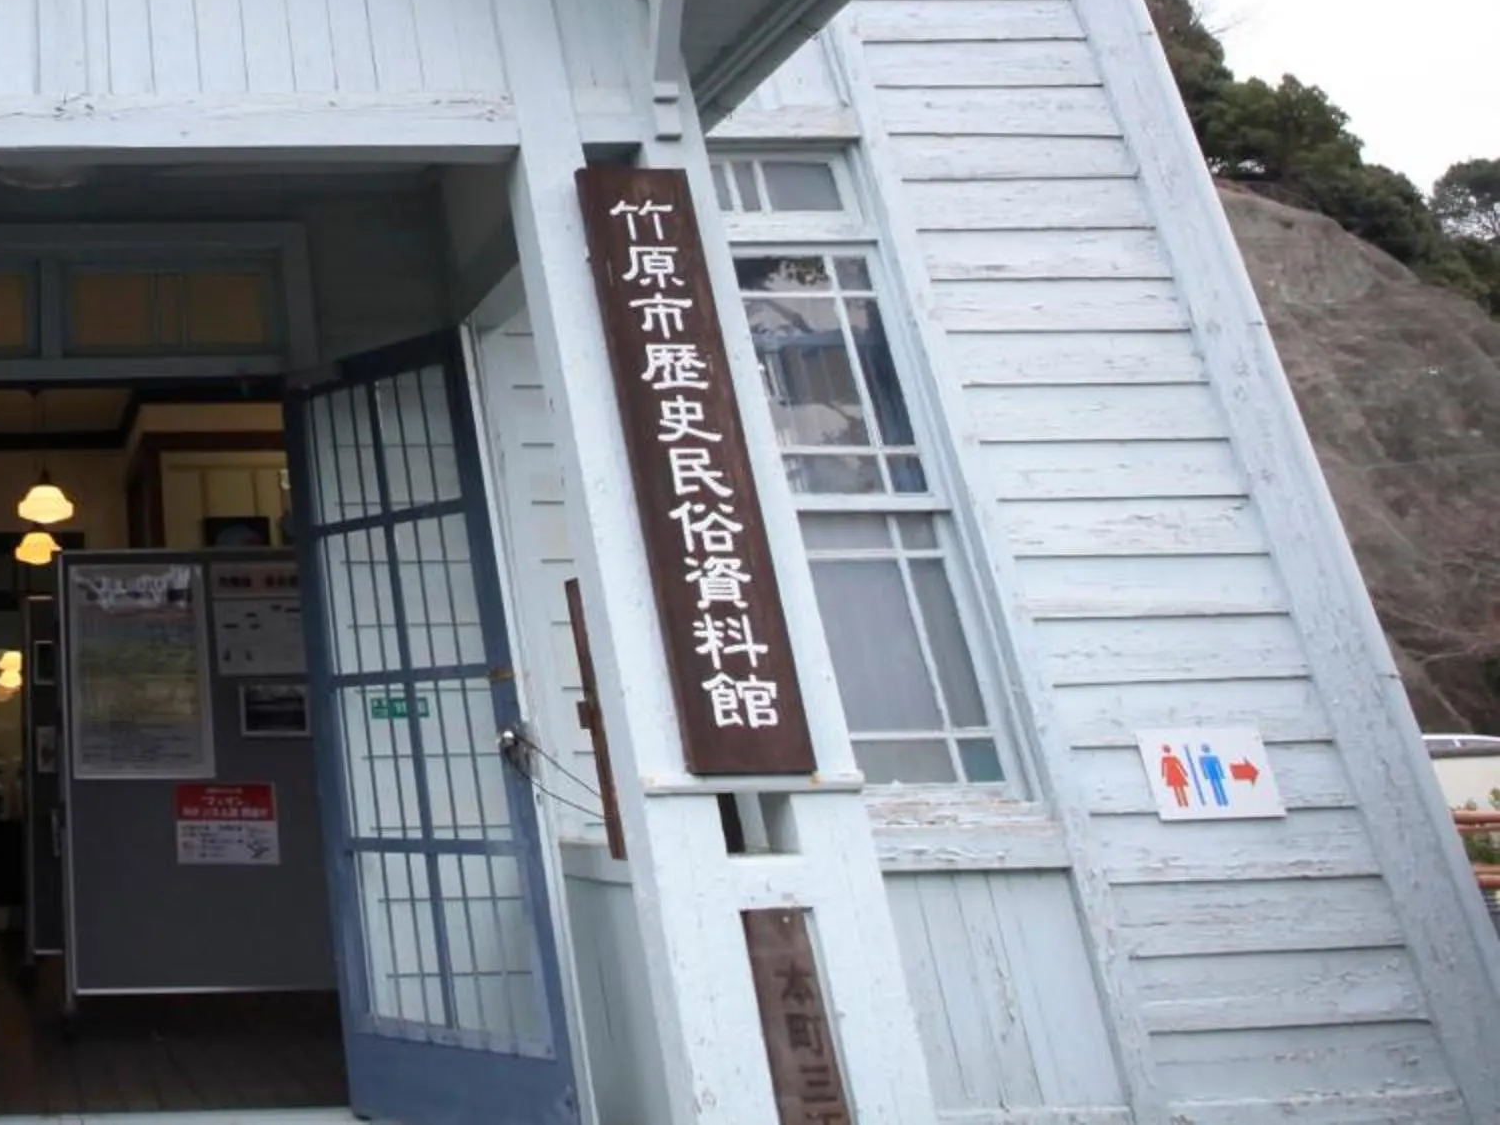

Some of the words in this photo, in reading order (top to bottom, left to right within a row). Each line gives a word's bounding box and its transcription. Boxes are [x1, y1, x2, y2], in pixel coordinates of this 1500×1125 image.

[609, 199, 780, 729] 竹原市歴史民俗資料館
